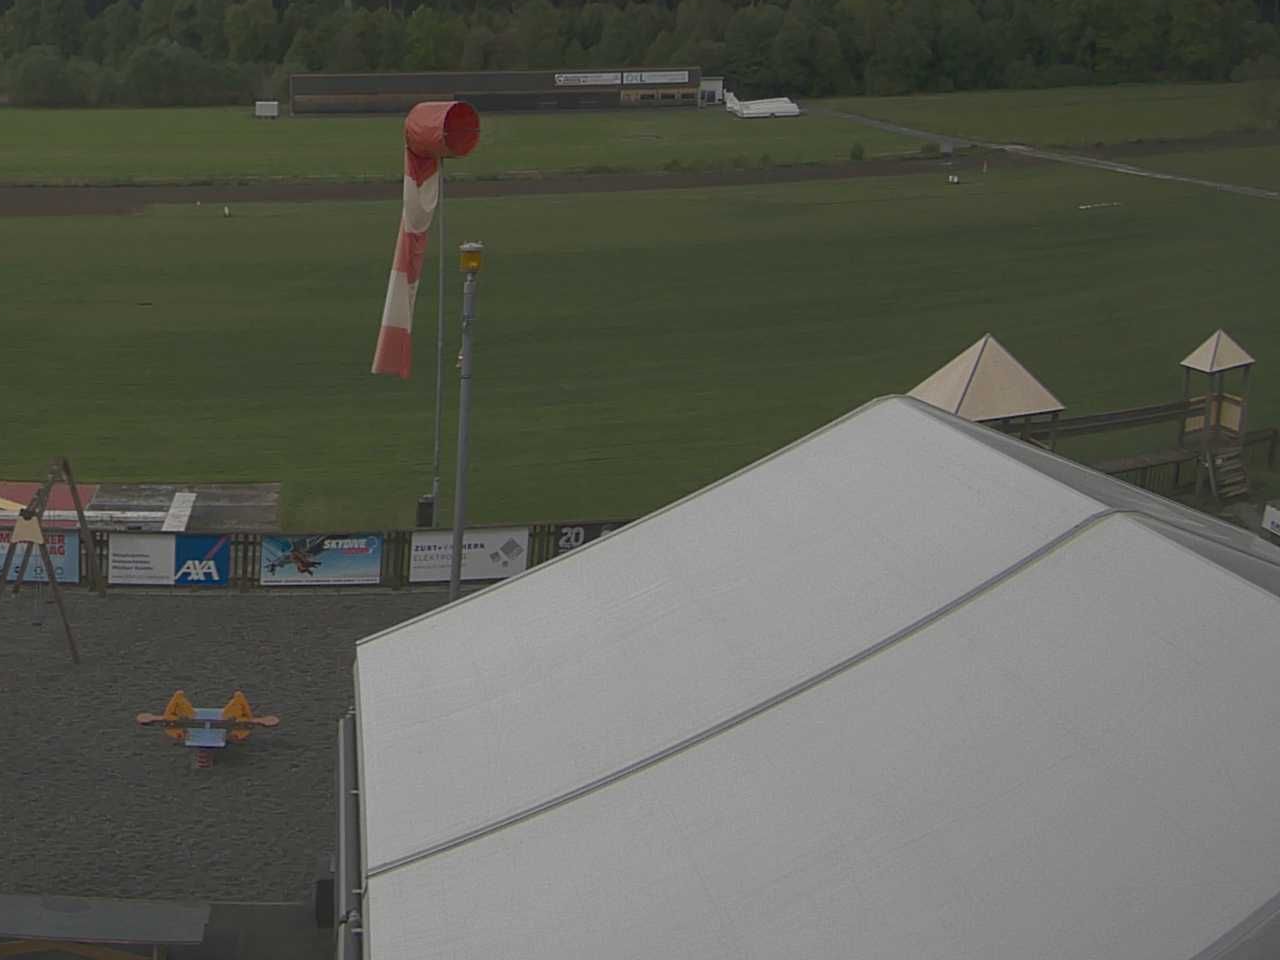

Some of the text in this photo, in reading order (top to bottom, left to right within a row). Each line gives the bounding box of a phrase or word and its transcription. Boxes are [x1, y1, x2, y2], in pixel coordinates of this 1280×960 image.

[323, 538, 367, 549] SKYDIVE
[559, 527, 584, 548] 20
[175, 560, 220, 581] AXA
